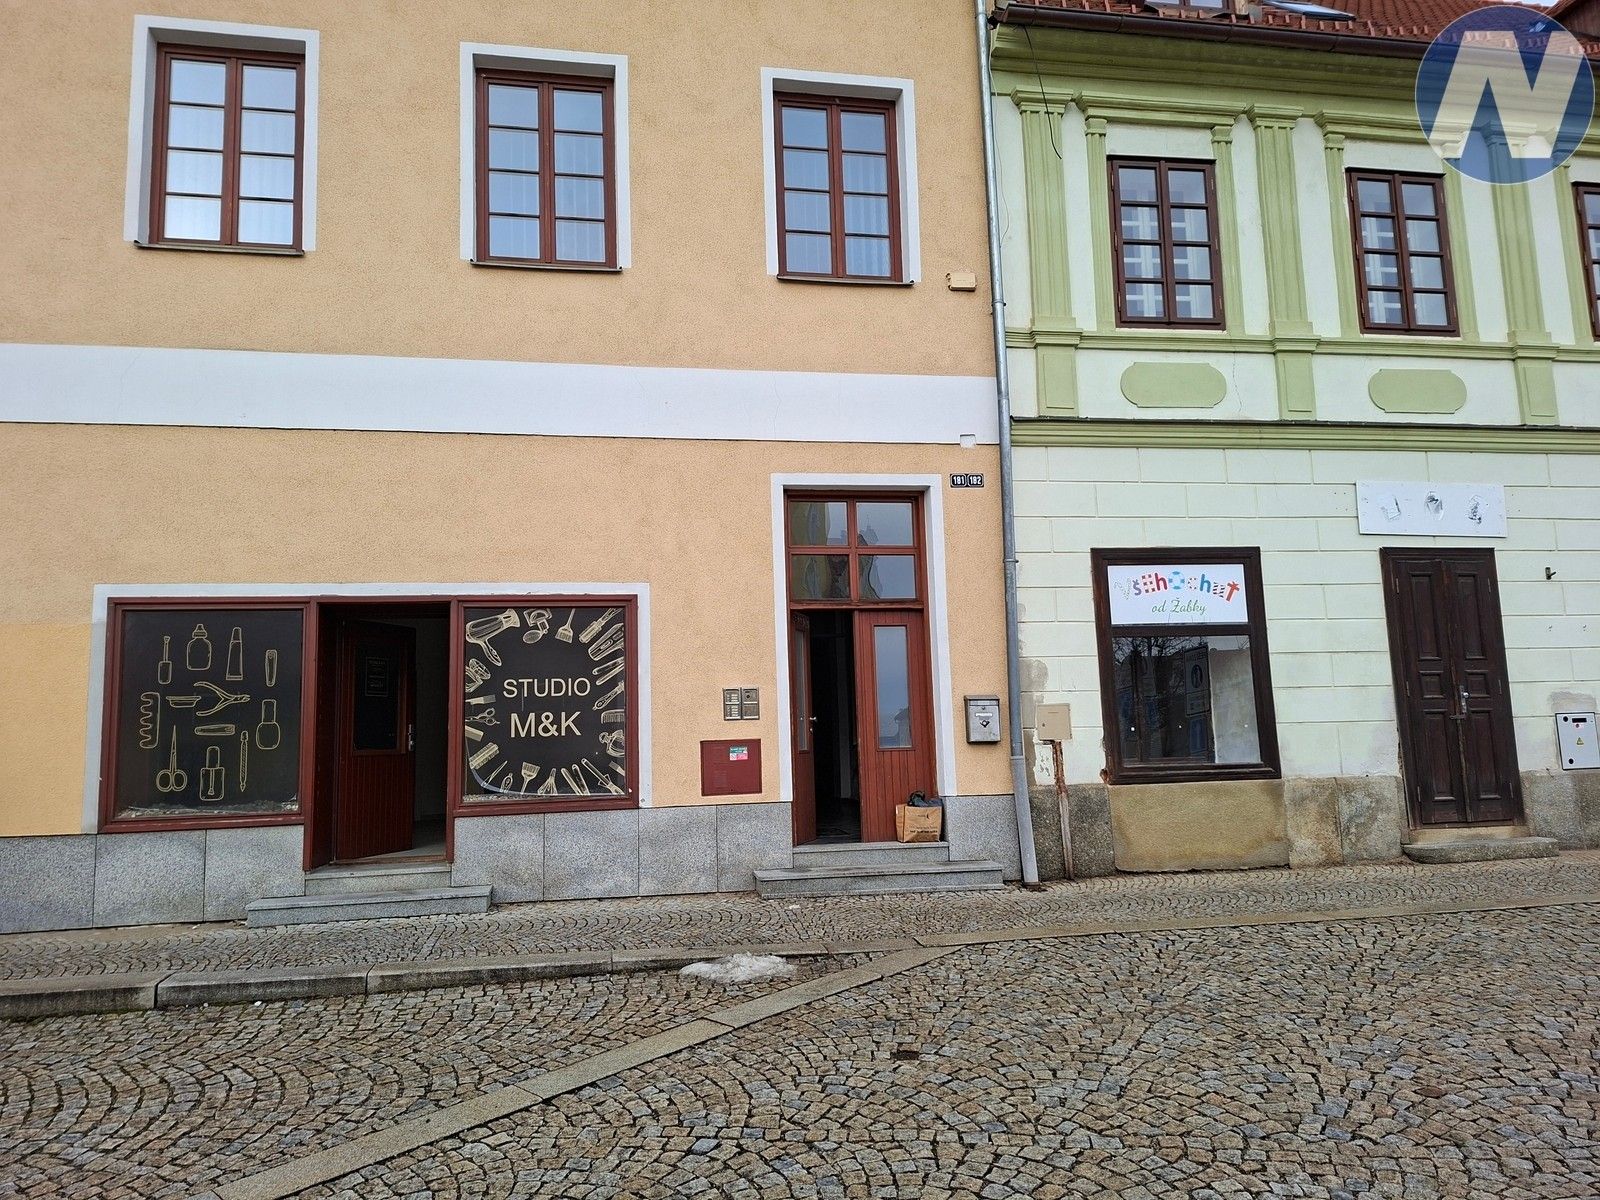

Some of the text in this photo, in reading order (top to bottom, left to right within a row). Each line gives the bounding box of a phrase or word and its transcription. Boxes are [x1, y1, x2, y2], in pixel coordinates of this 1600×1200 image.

[1151, 597, 1207, 616] od Žabky
[503, 677, 591, 698] STUDIO
[510, 711, 582, 738] M&K
